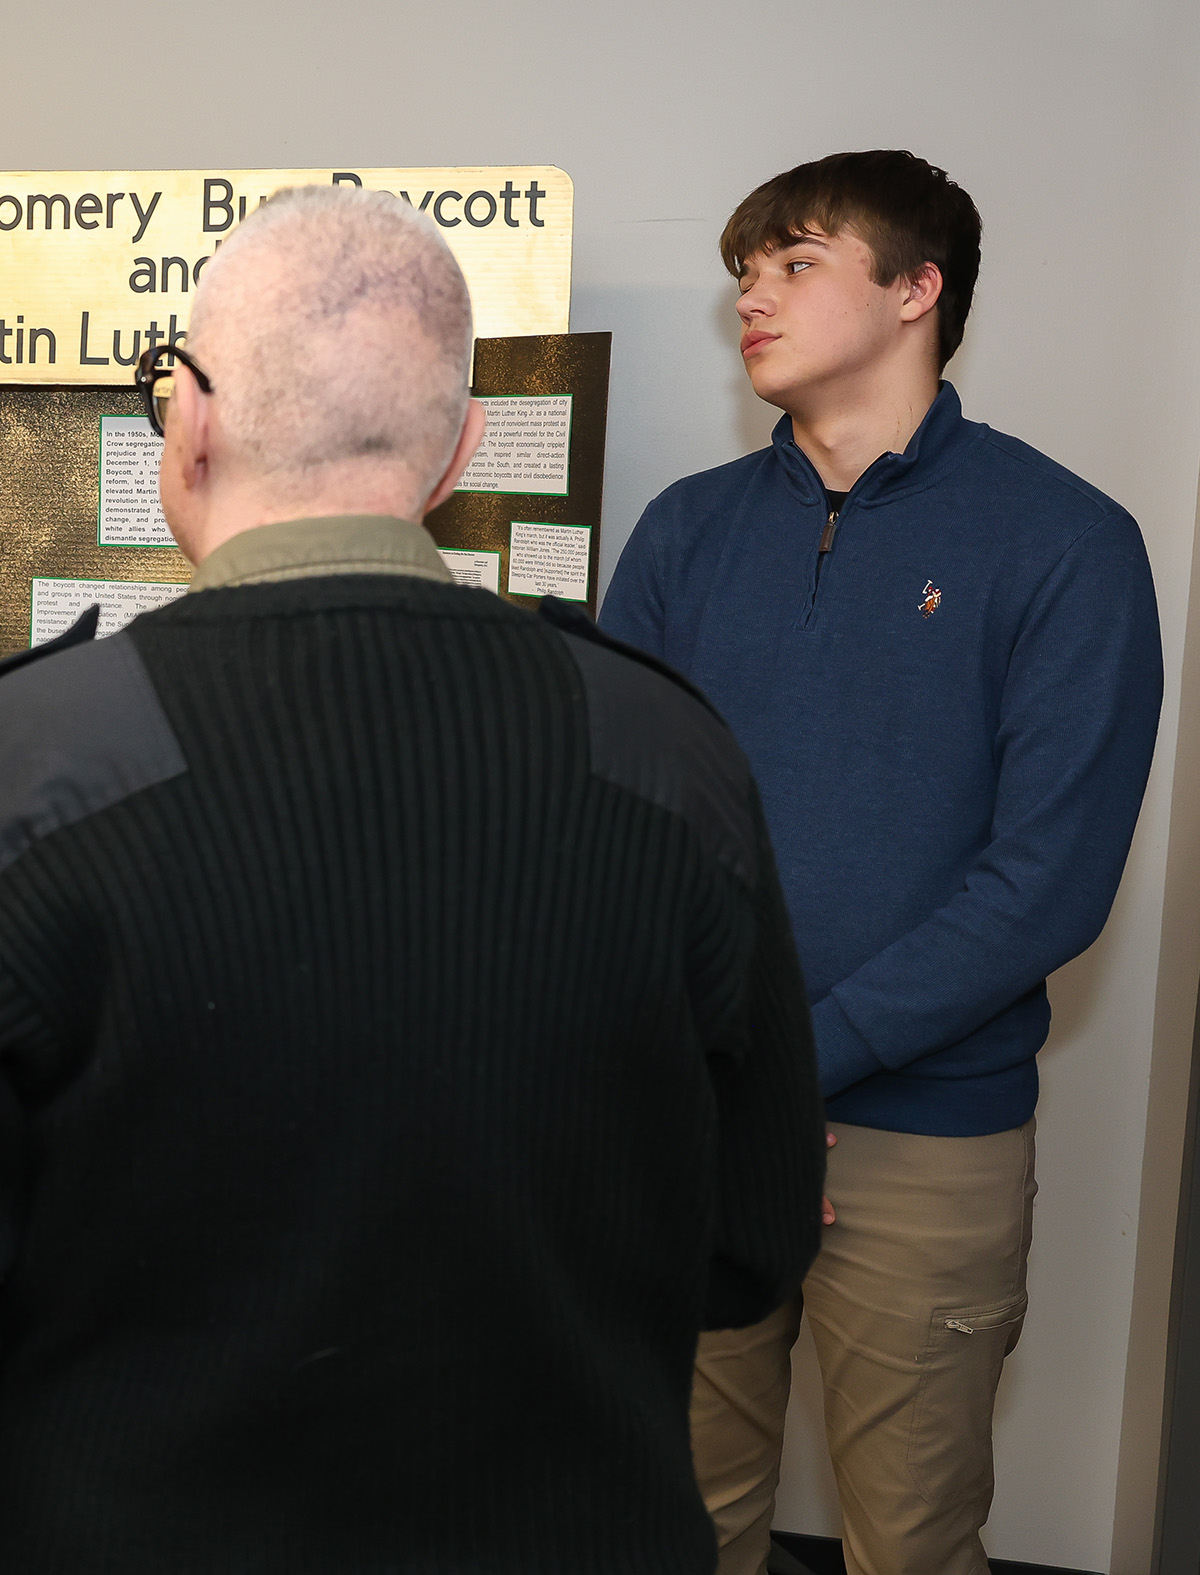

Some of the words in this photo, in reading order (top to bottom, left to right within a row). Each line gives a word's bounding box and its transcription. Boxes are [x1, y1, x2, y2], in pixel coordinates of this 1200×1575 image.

[79, 311, 188, 366] Luth
[519, 399, 551, 408] desegregation
[559, 399, 568, 407] city
[517, 410, 527, 418] King
[126, 441, 164, 449] segregation
[106, 450, 136, 458] prejudice
[106, 469, 133, 477] Boycott,
[106, 478, 129, 486] reform,
[105, 516, 131, 524] change,
[53, 582, 75, 590] boycott
[79, 583, 105, 591] changed
[109, 584, 147, 593] relationships
[139, 594, 164, 602] through
